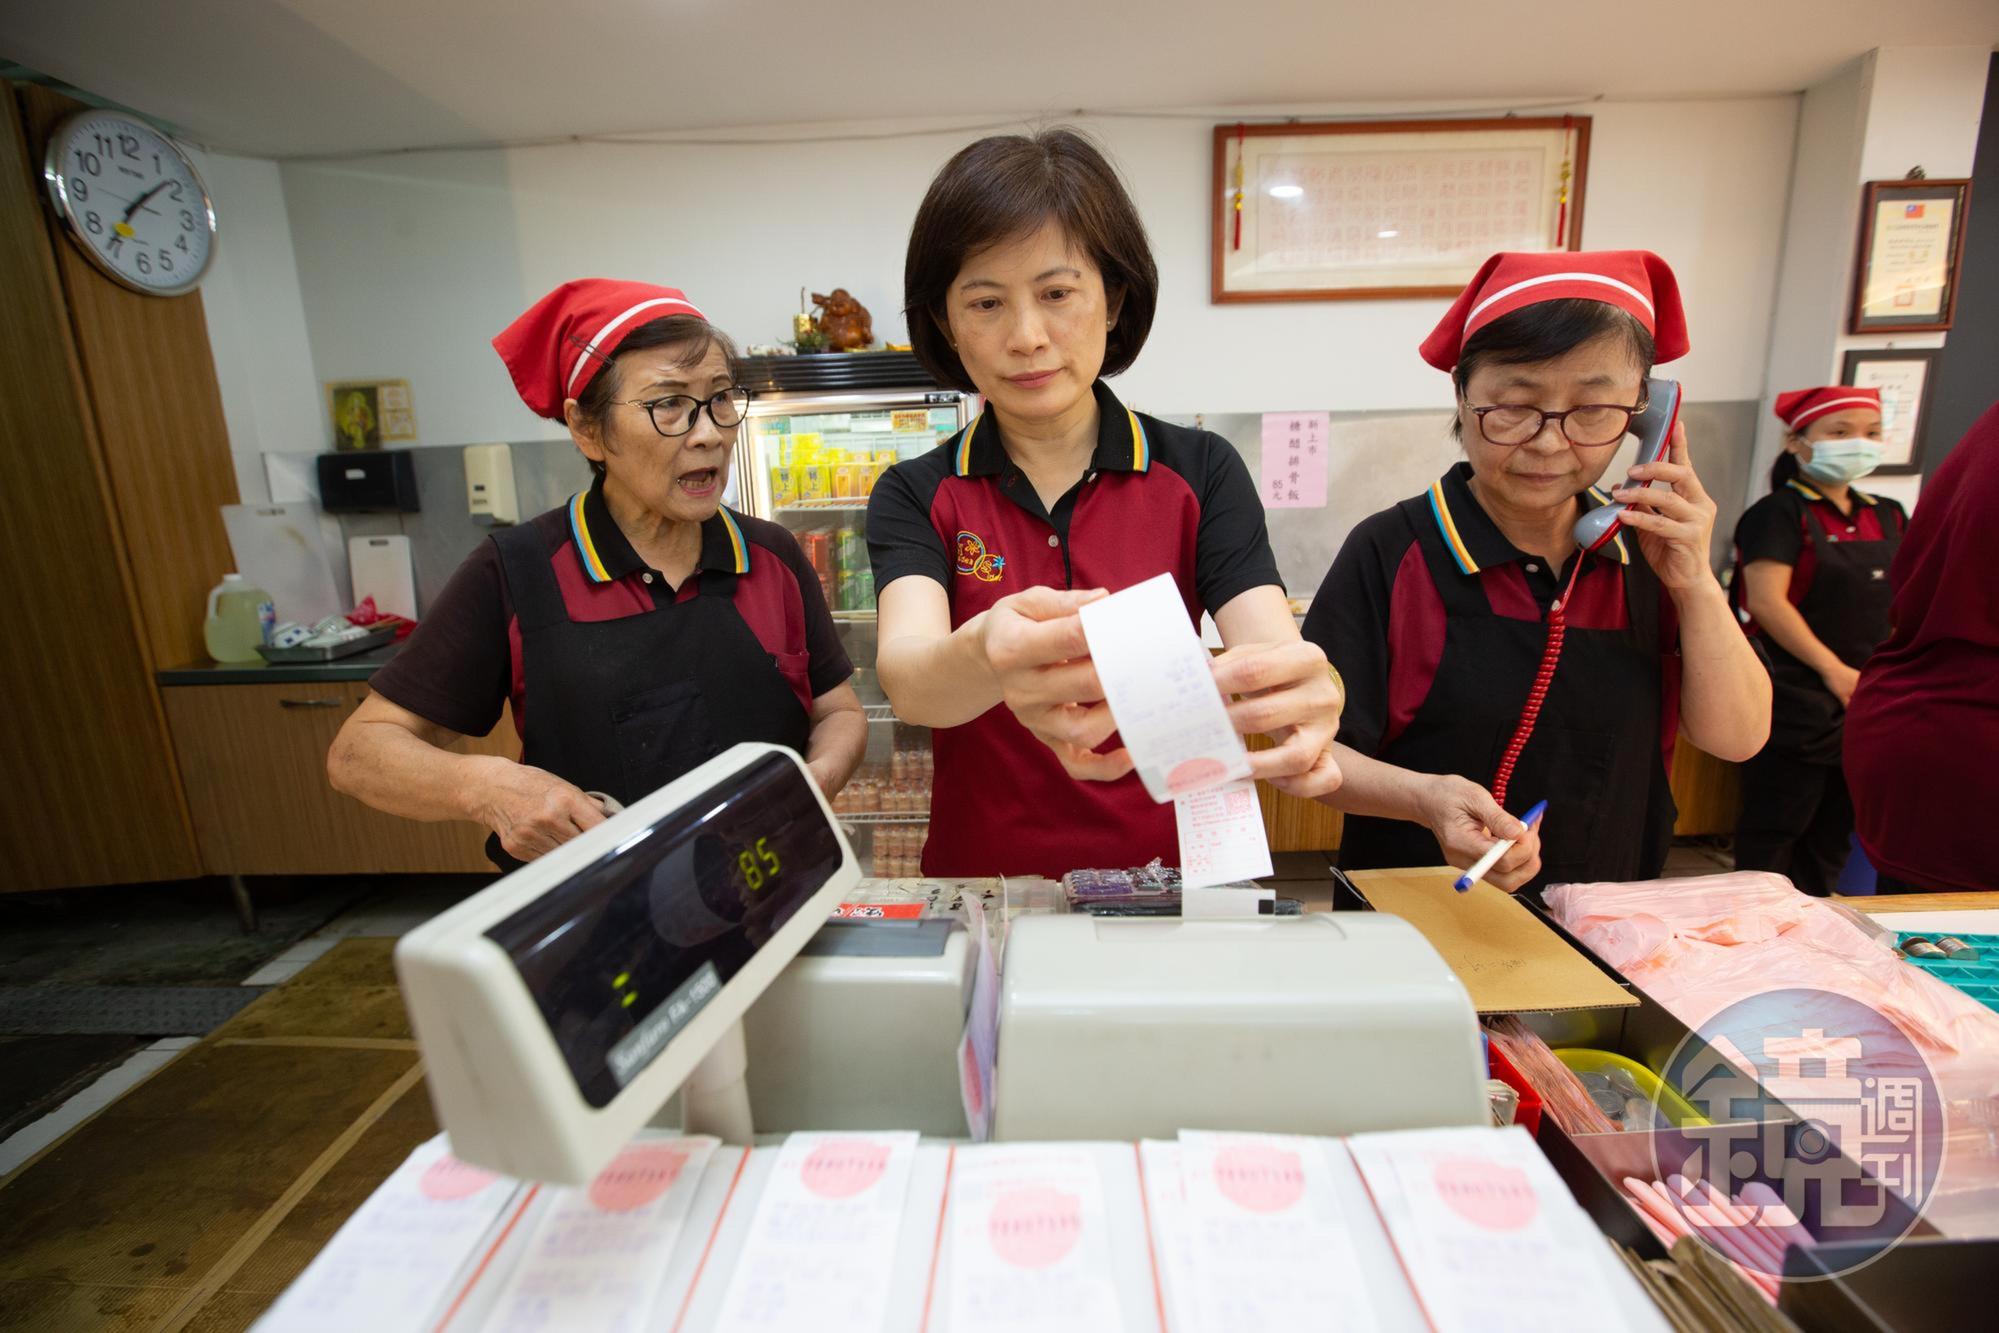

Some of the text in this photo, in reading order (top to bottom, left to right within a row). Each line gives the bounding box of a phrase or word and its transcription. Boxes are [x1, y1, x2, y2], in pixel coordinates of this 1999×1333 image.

[94, 133, 114, 160] 11
[117, 134, 141, 161] 12
[74, 147, 101, 177] 10
[152, 153, 162, 176] 1
[71, 177, 88, 202] 9
[168, 179, 184, 204] 2
[85, 211, 103, 235] 8
[180, 209, 196, 232] 3
[174, 233, 189, 255] 4
[135, 252, 152, 275] 6
[159, 247, 174, 272] 5
[738, 836, 780, 890] 85
